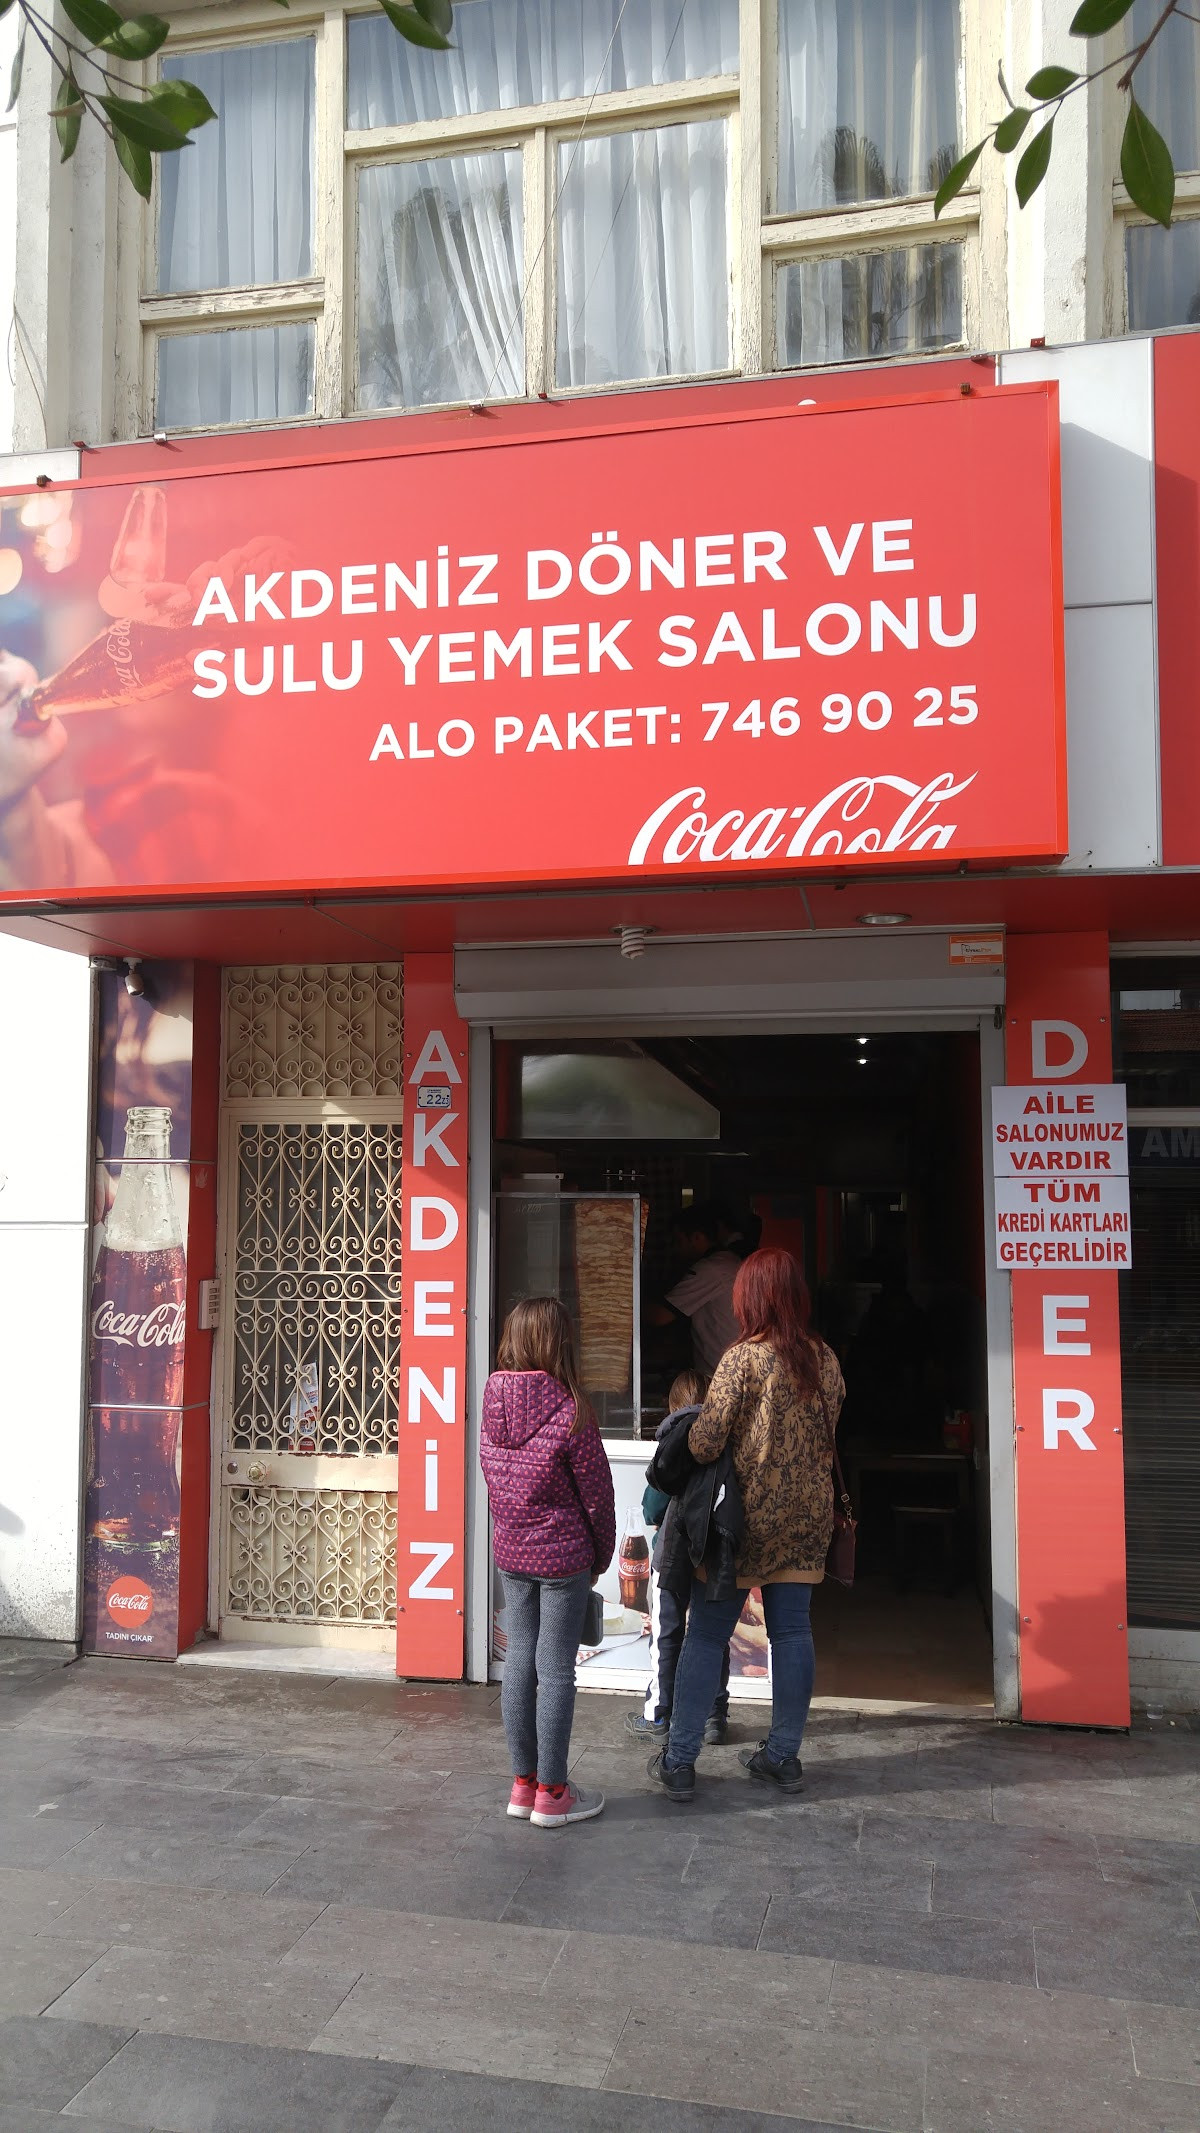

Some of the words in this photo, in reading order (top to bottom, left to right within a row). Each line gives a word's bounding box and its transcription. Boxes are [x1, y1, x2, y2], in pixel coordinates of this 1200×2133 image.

[192, 545, 498, 627] AKDENİZ
[527, 531, 788, 600] DÖNER
[813, 519, 914, 576] VE
[192, 640, 363, 699] SULU
[388, 620, 633, 685] YEMEK
[658, 594, 976, 667] SALONU
[369, 719, 475, 761] ALO
[495, 706, 680, 754] PAKET:
[702, 697, 800, 741] 746
[822, 691, 892, 733] 90
[914, 685, 978, 727] 25
[628, 770, 978, 866] Coca-Cola
[1023, 1091, 1095, 1115] AİLE
[996, 1122, 1124, 1143] SALONUMUZ
[1010, 1150, 1112, 1171] VARDIR
[1023, 1180, 1101, 1204] TÜM
[998, 1208, 1045, 1233] KREDİ
[1050, 1212, 1128, 1233] KARTLARI
[1000, 1237, 1128, 1267] GEÇERLİDİR
[92, 1300, 186, 1347] Coca-Cola
[408, 1030, 462, 1602] AKDENİZ
[108, 1592, 151, 1611] Coca-Cola
[105, 1632, 129, 1641] TADINI
[130, 1634, 154, 1643] ÇIKAR
